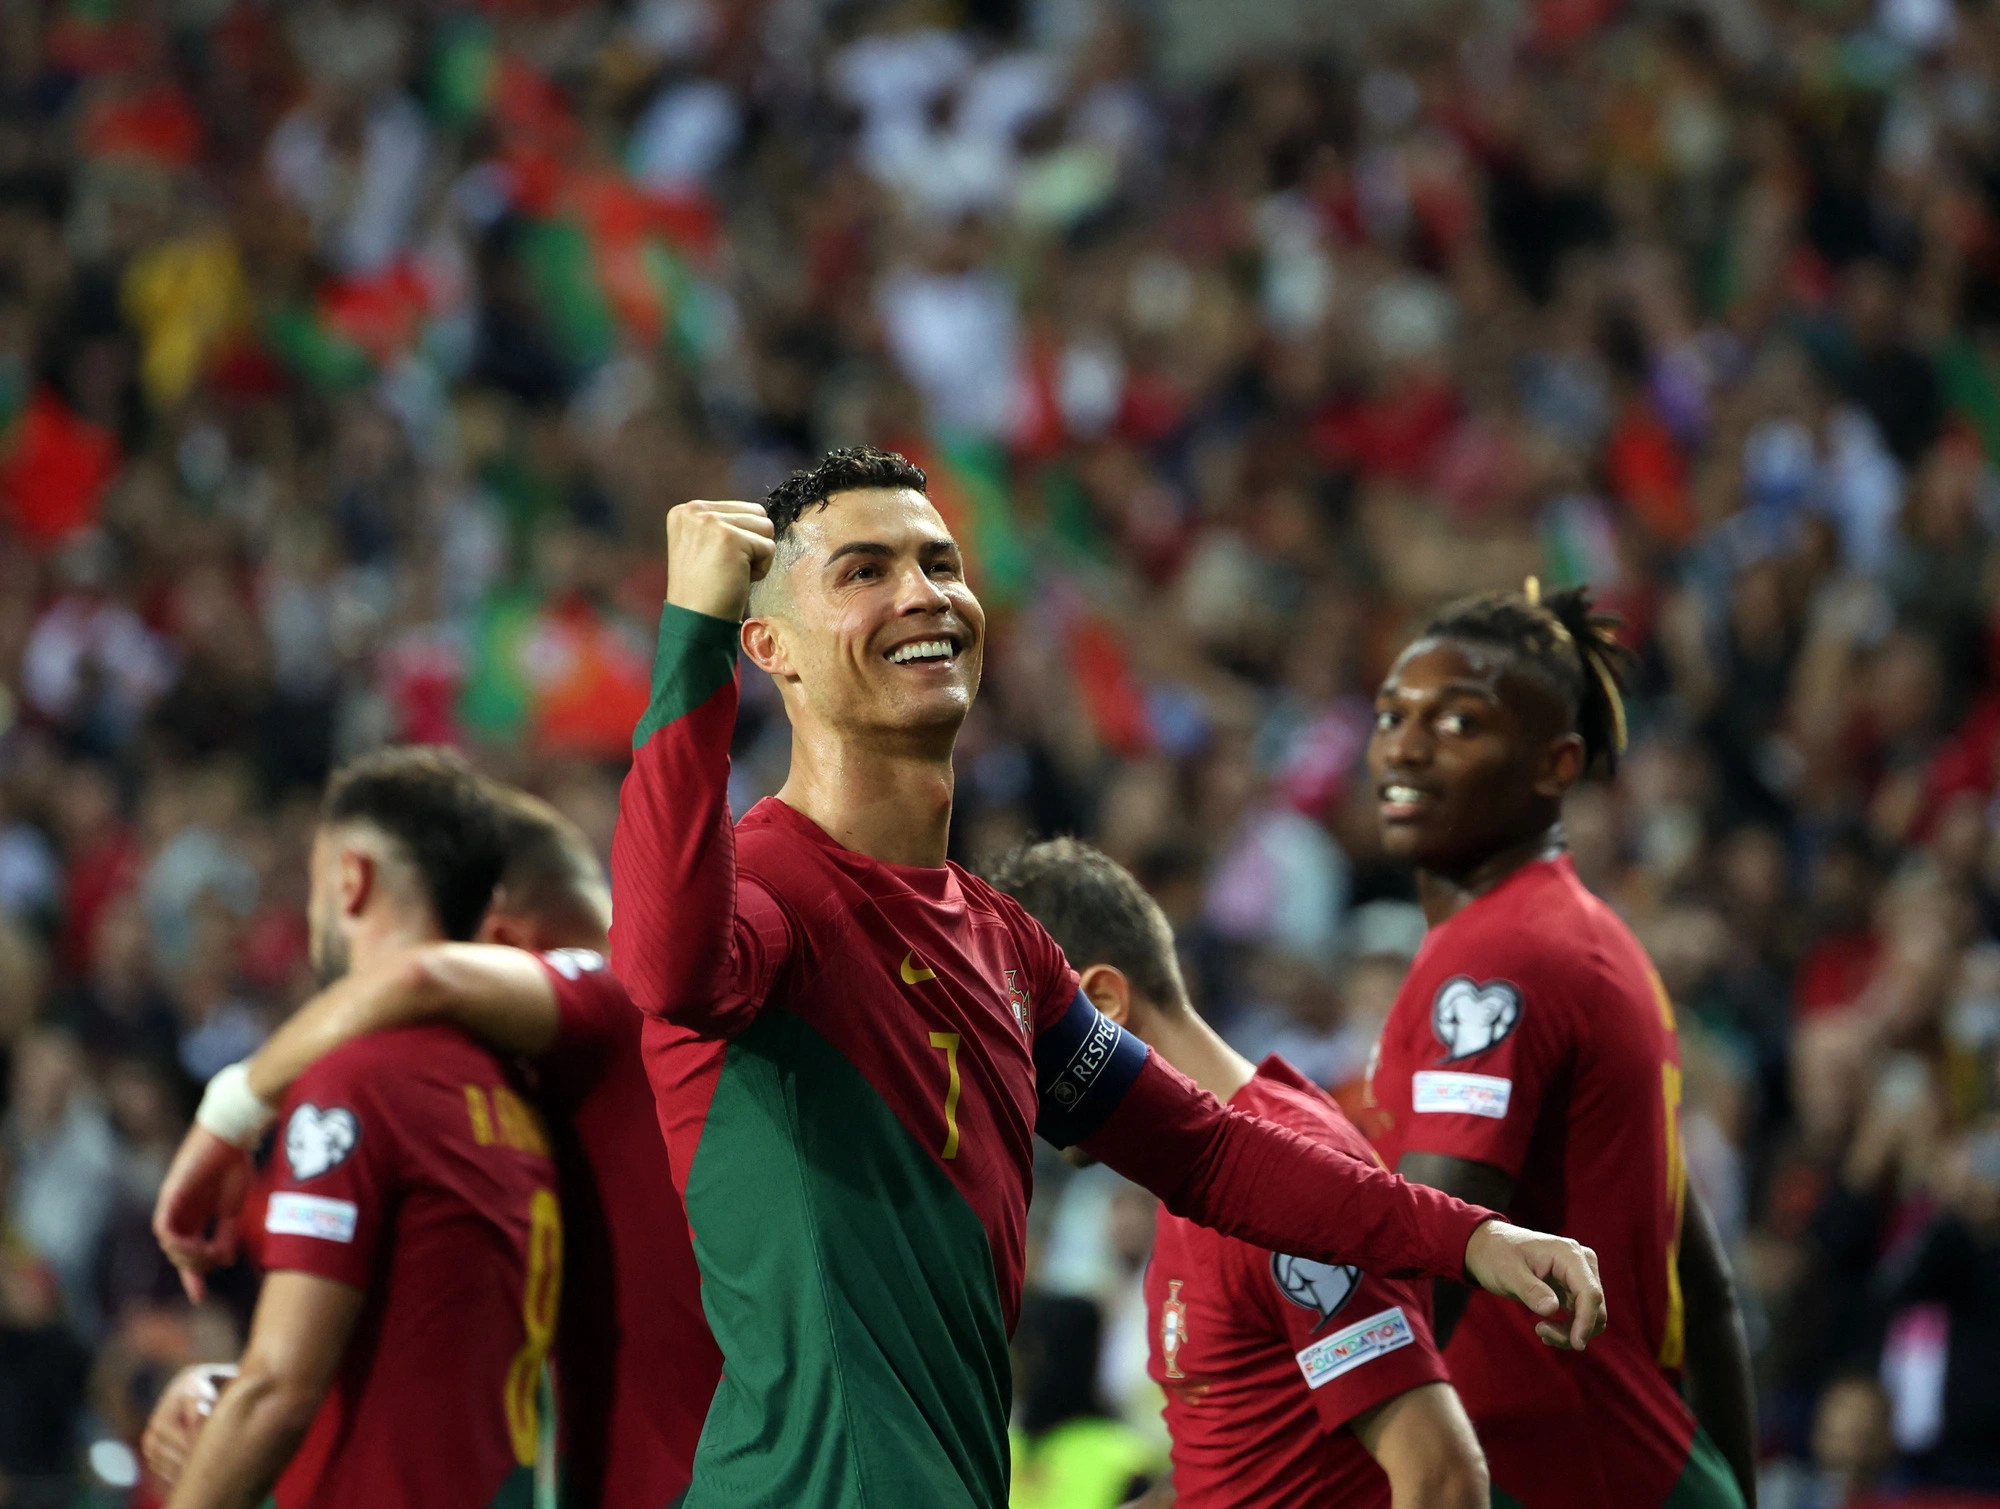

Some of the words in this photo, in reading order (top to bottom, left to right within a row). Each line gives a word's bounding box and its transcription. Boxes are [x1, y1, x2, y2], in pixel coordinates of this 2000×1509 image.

[929, 1031, 961, 1159] 7
[1073, 1012, 1116, 1082] RESPEC
[505, 1189, 564, 1467] 8
[1303, 1320, 1406, 1376] FOUNDATION
